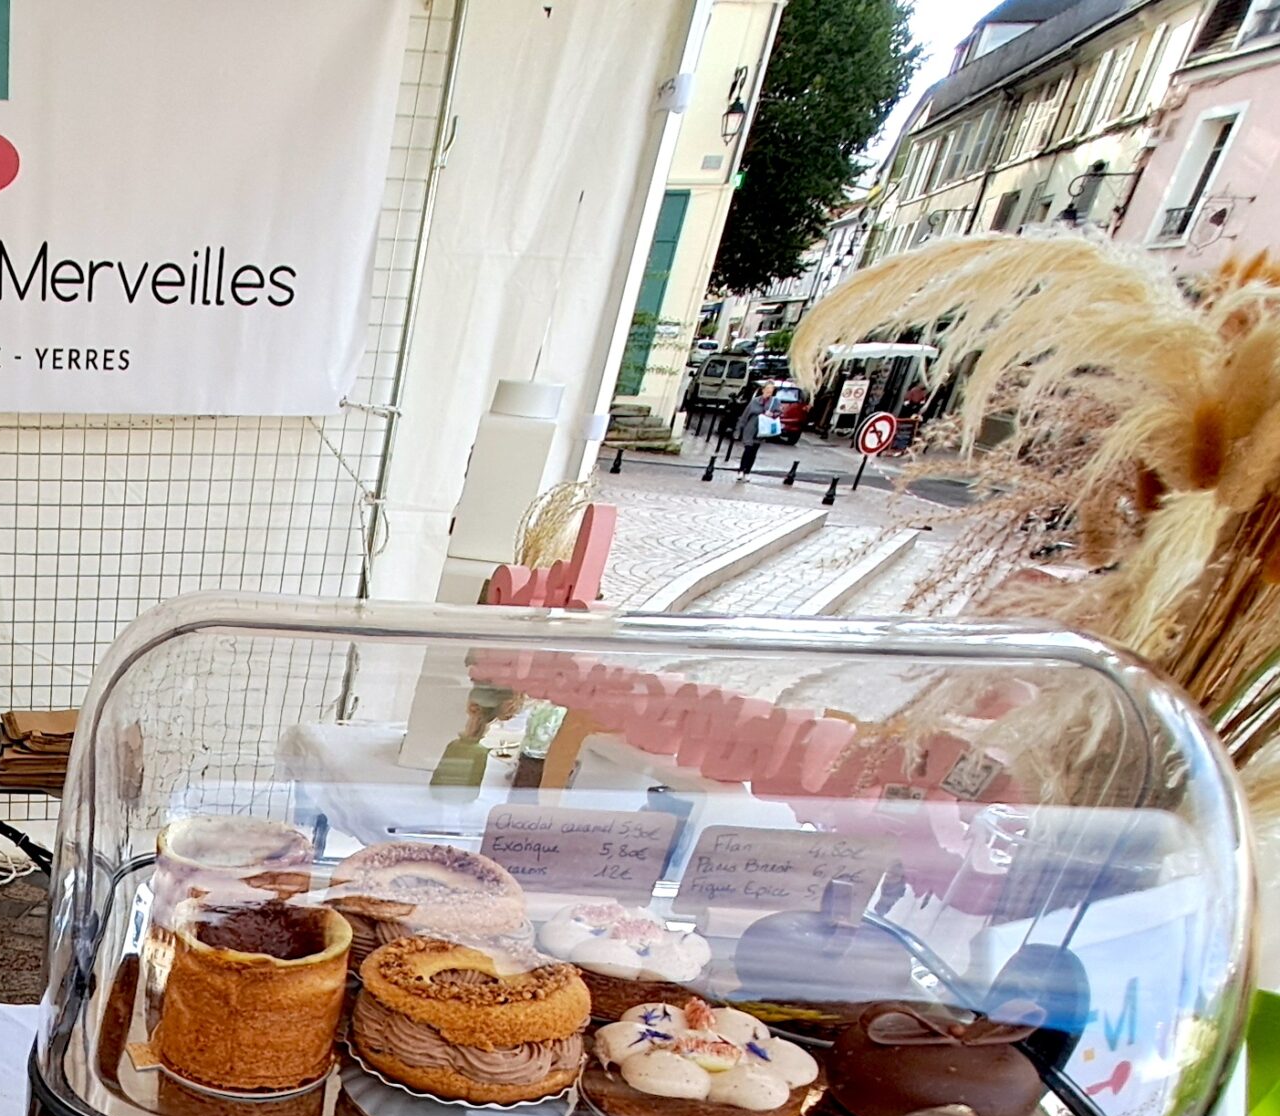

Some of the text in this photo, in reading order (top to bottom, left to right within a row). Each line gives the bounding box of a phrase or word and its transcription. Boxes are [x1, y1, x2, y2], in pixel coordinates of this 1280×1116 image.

[34, 347, 131, 371] YERRES
[560, 816, 614, 835] caramel
[598, 842, 648, 861] 5,80€
[714, 833, 753, 853] Flan
[593, 864, 633, 881] 12€
